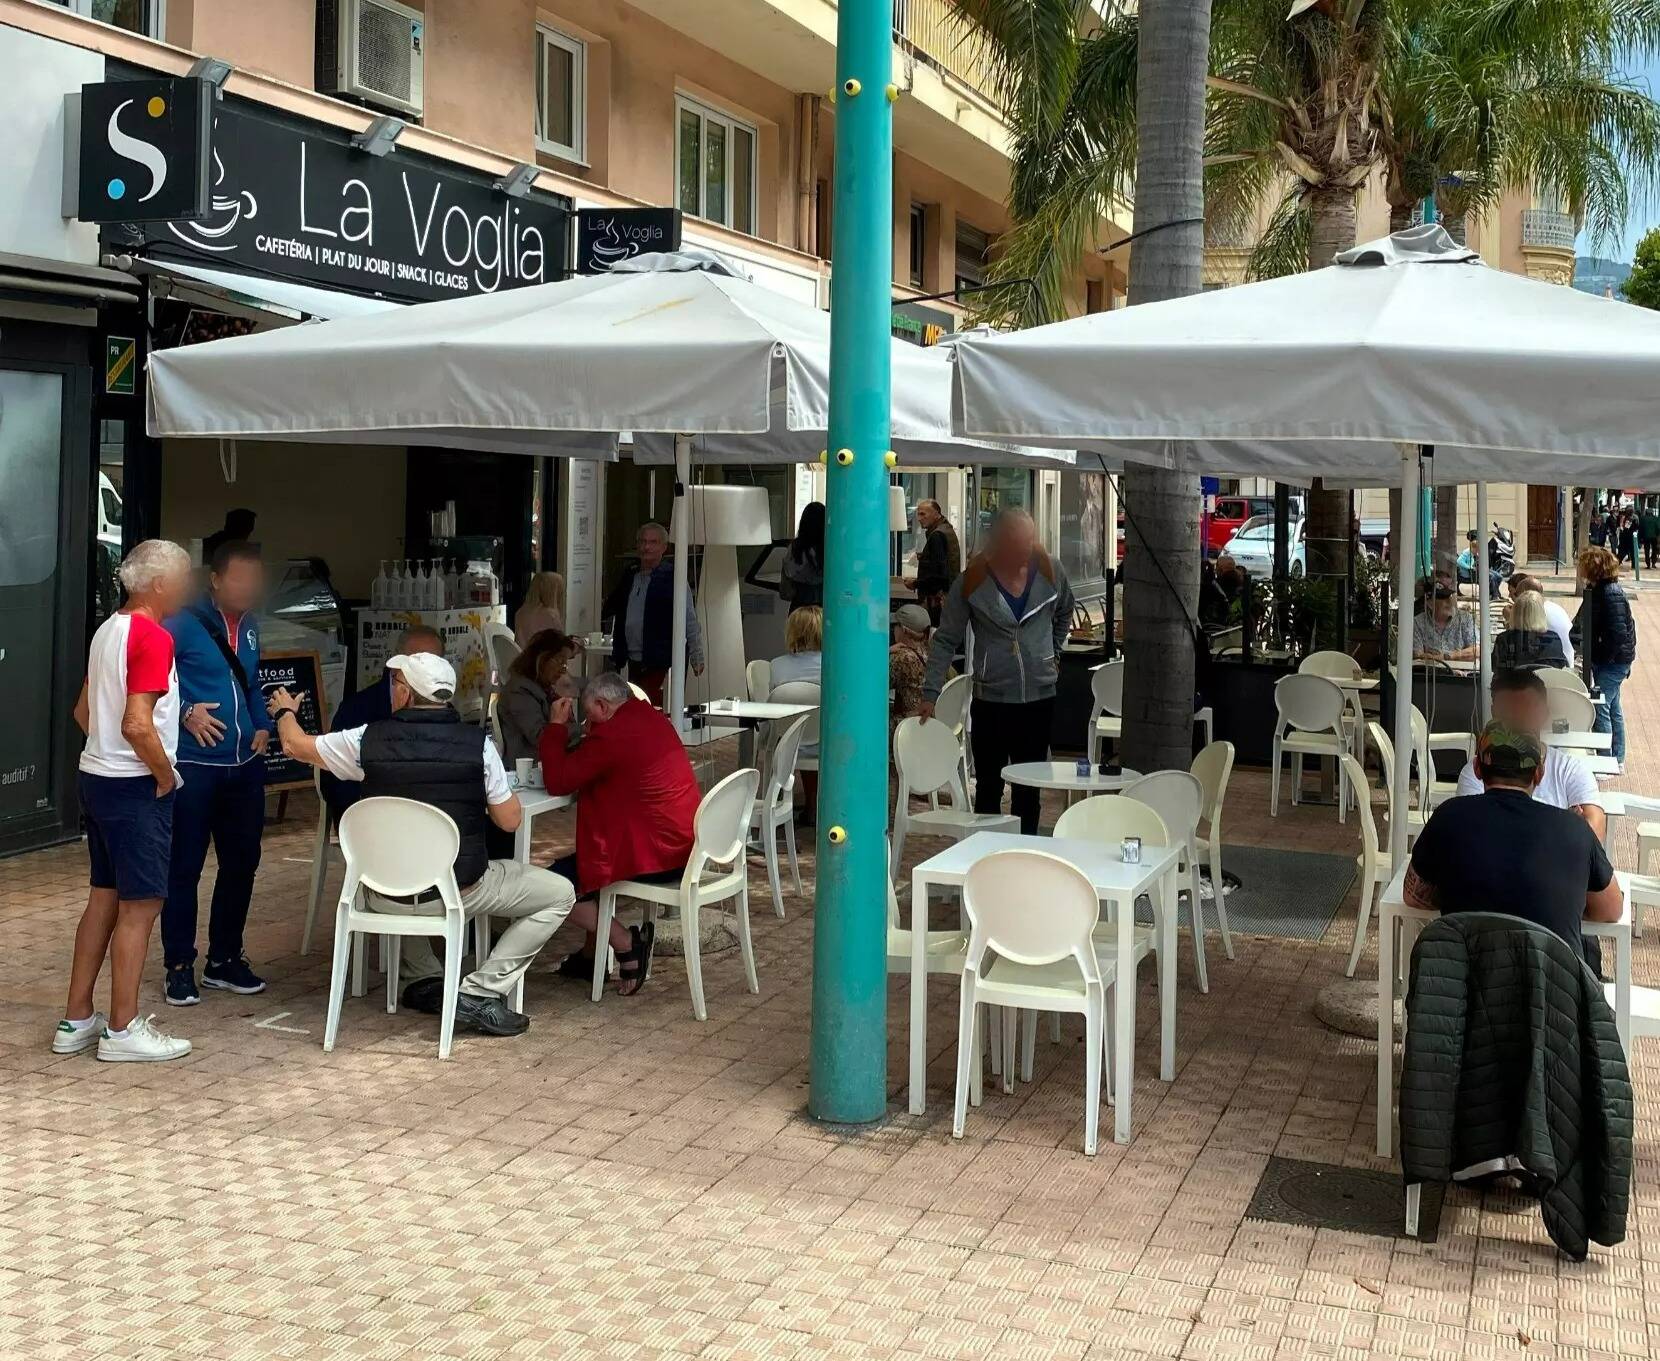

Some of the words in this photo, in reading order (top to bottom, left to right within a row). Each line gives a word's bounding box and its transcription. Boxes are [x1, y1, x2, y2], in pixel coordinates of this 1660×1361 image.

[300, 141, 373, 247] La
[402, 171, 544, 293] Voglia
[587, 216, 606, 231] La
[621, 224, 663, 243] Voglia
[255, 234, 313, 261] CAFETÉRIA
[322, 247, 346, 267] PLAT
[347, 252, 362, 270] DU
[364, 256, 390, 276] JOUR
[397, 263, 427, 283] SNACK
[434, 271, 469, 290] GLACES
[258, 667, 295, 678] tfood
